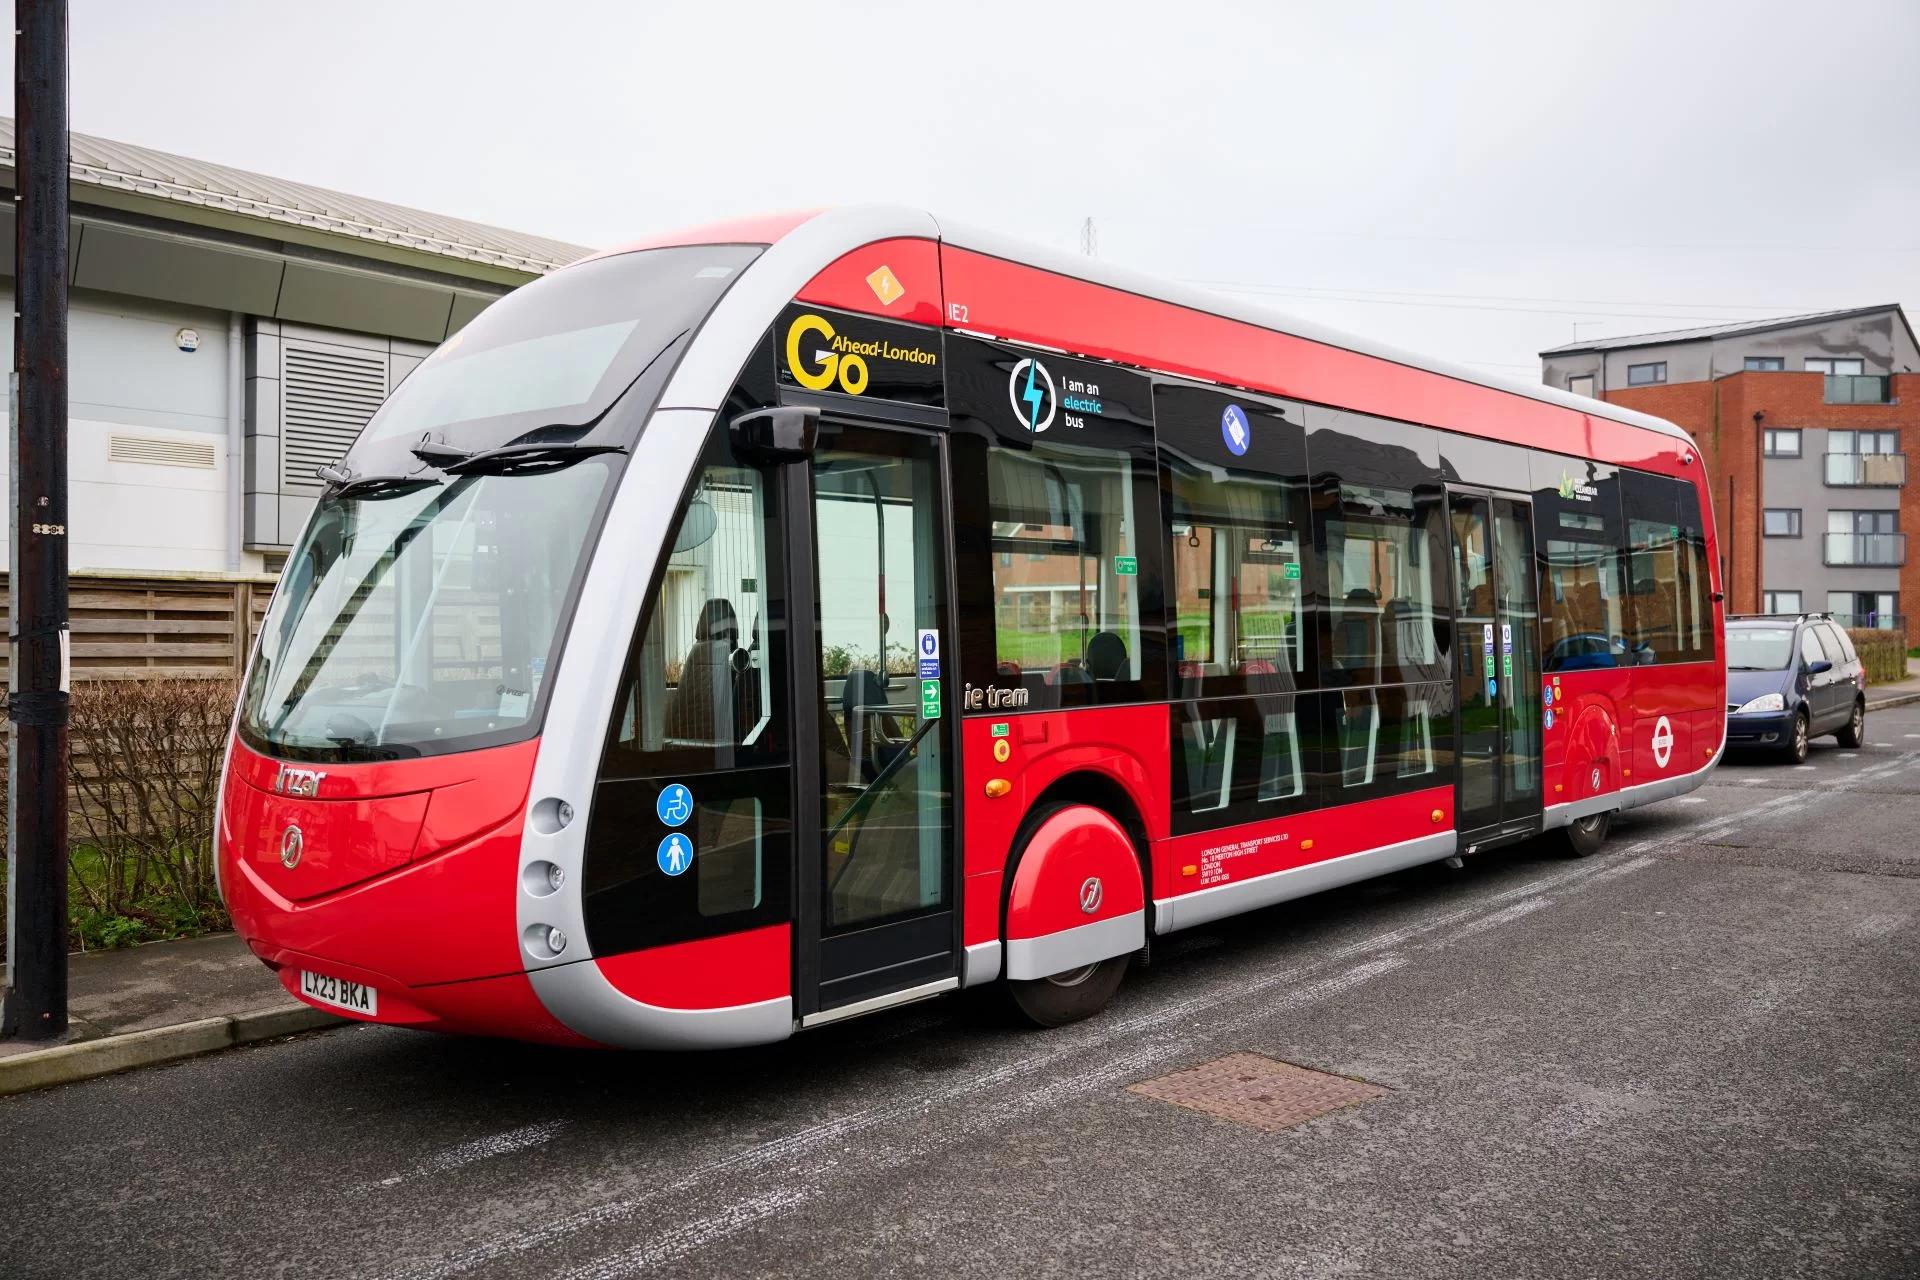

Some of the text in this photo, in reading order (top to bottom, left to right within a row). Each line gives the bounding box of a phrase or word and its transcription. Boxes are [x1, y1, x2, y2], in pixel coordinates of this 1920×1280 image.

[948, 302, 969, 323] IE2
[786, 314, 936, 395] Go Ahead-London
[1062, 376, 1100, 396] I am an
[1064, 396, 1102, 414] electric
[1064, 412, 1085, 429] bus
[964, 682, 984, 710] ie
[986, 684, 1029, 708] tram
[1201, 847, 1221, 857] LONDON
[1221, 843, 1239, 853] GENERAL
[1240, 838, 1263, 848] TRANSPORT
[1263, 834, 1280, 844] SERVICES
[1215, 851, 1233, 861] MERTON
[1244, 845, 1259, 855] STREET
[1201, 861, 1221, 871] LONDON
[304, 970, 370, 1010] LX23 BKA
